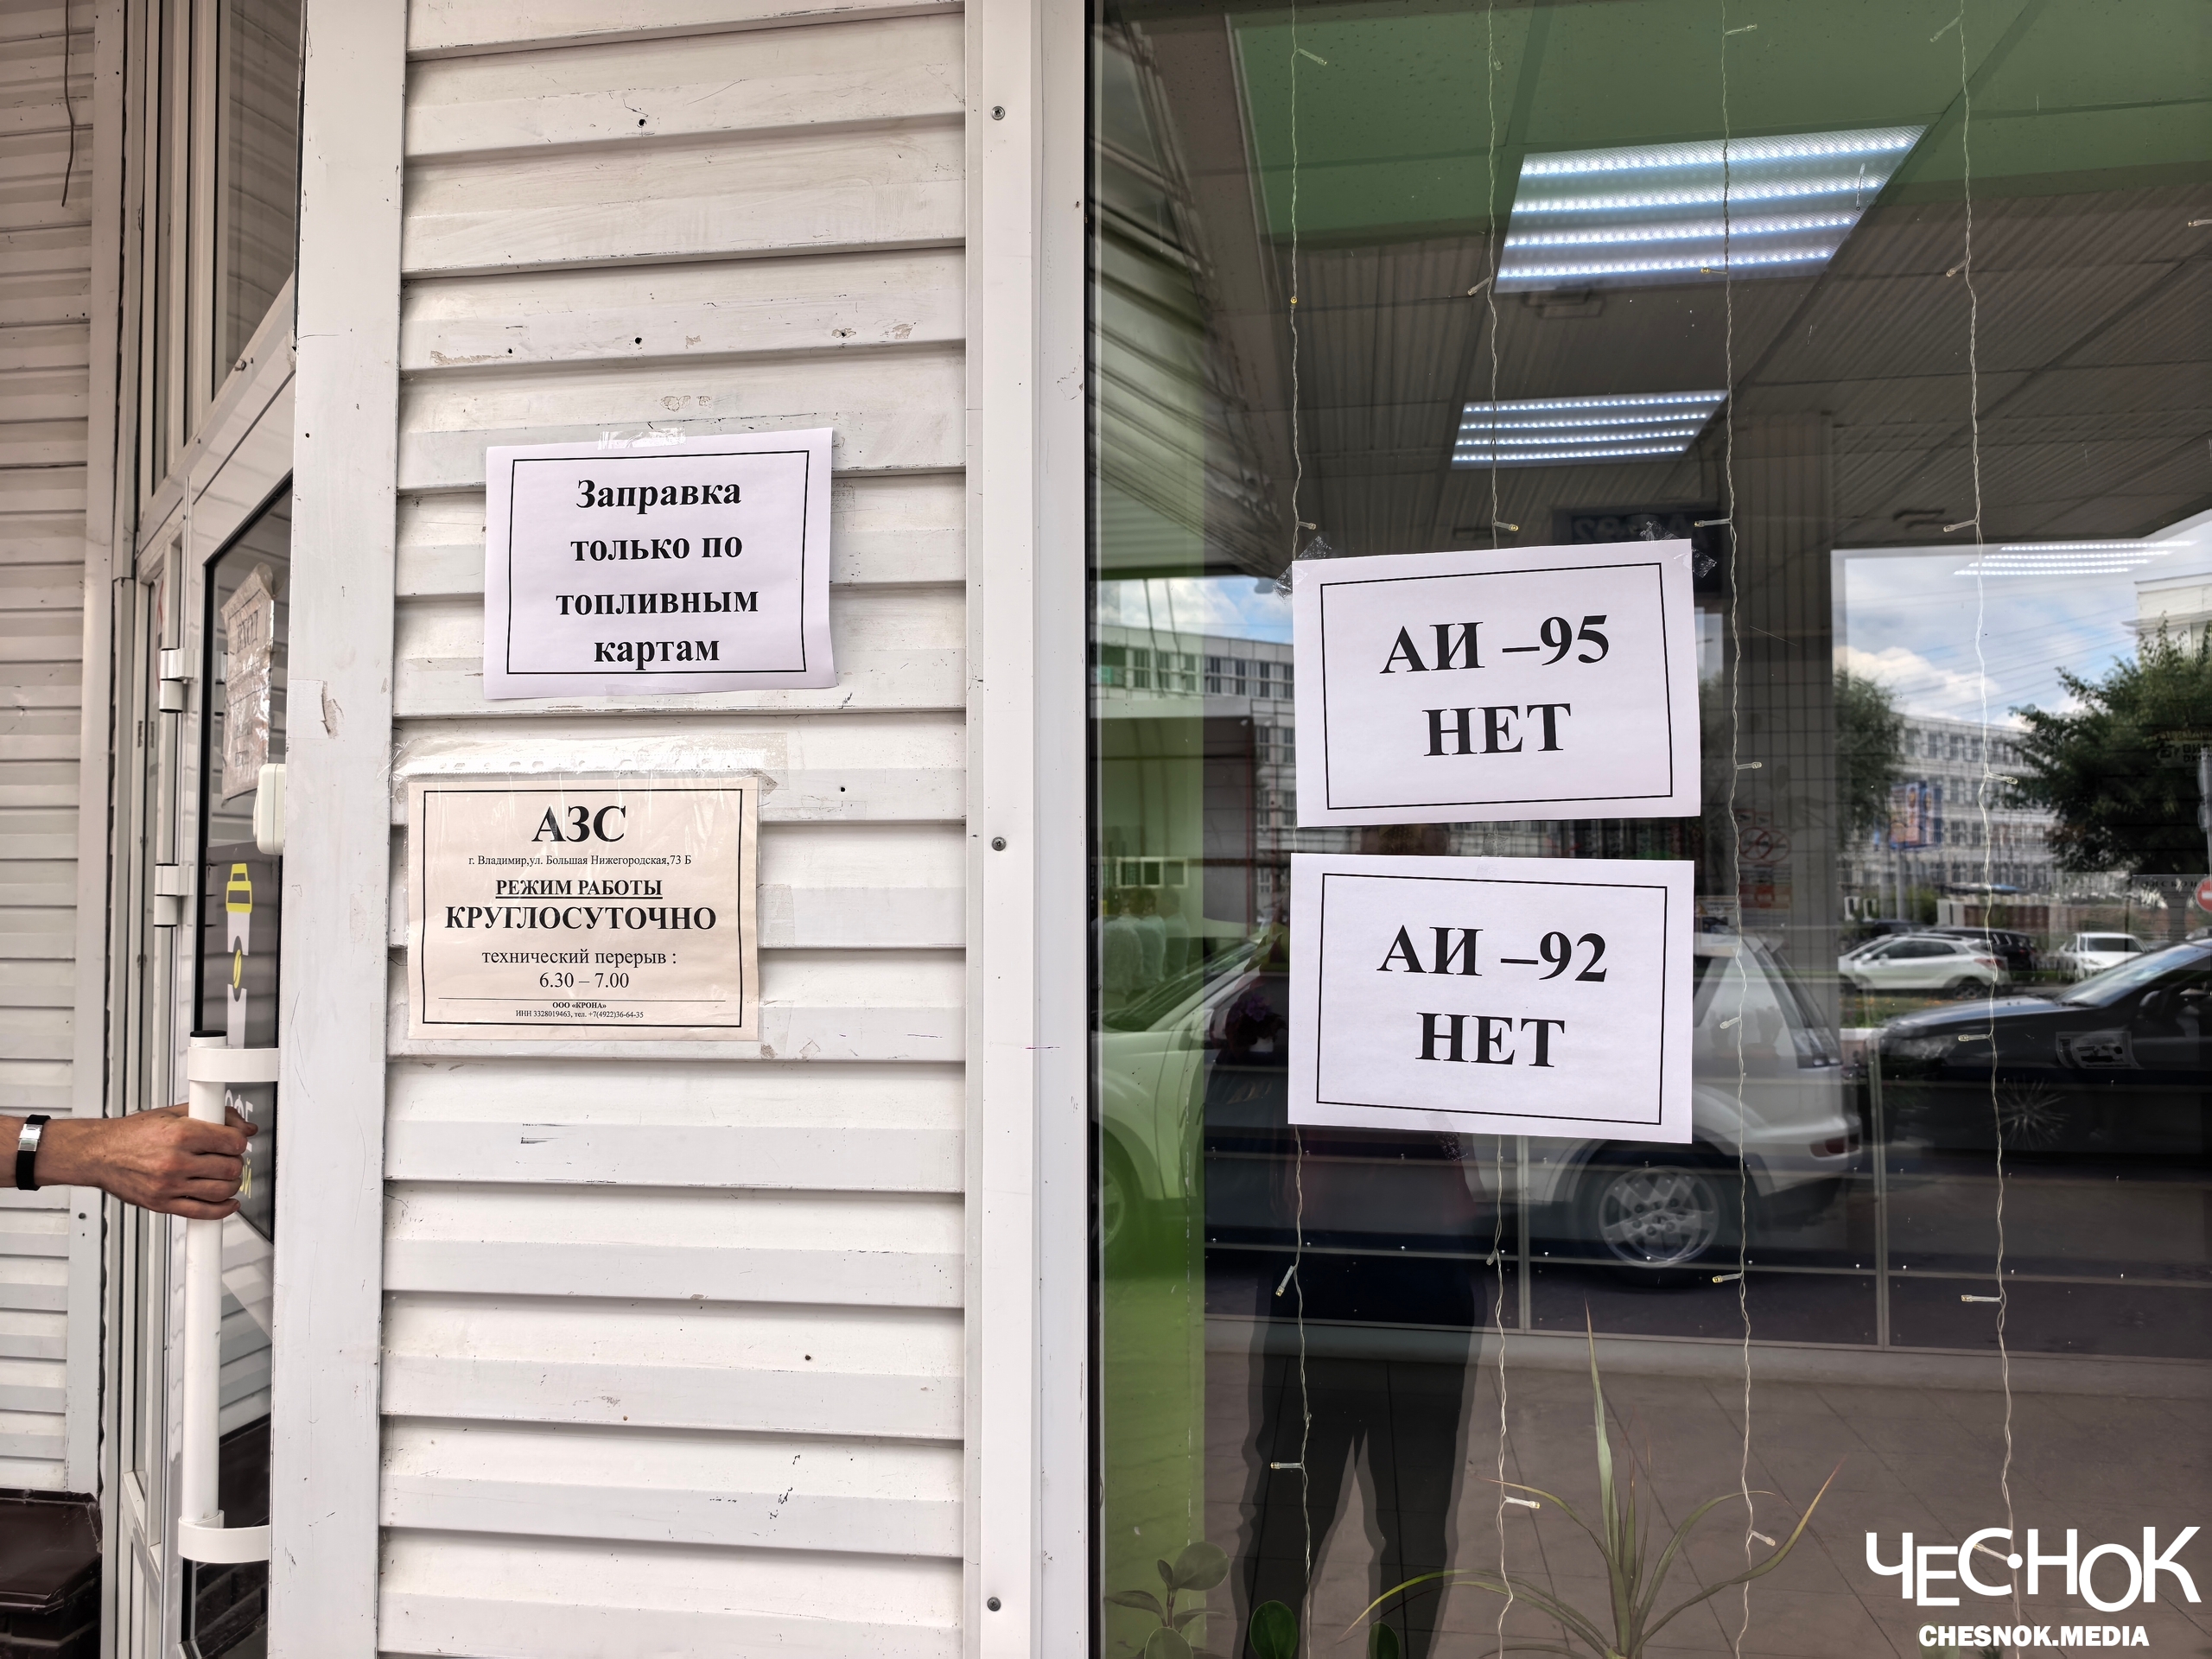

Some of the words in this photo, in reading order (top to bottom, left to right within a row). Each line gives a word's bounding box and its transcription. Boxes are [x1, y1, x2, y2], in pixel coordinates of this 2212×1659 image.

[575, 480, 742, 515] Заправка
[570, 537, 690, 562] только
[701, 537, 743, 558] по
[556, 591, 759, 616] топливным
[594, 640, 720, 671] картам
[1379, 621, 1485, 674] АИ
[1502, 614, 1610, 666] –95
[1421, 702, 1572, 757] НЕТ
[531, 805, 626, 842] АЗС
[546, 855, 588, 865] Большая
[590, 855, 682, 868] Нижегородская,73
[684, 855, 691, 865] Б
[496, 880, 572, 895] РЕЖИМ
[578, 880, 663, 896] РАБОТЫ
[445, 906, 716, 931] КРУГЛОСУТОЧНО
[481, 948, 589, 963] технический
[594, 952, 667, 969] перерыв
[1376, 924, 1484, 976] АИ
[1500, 931, 1607, 982] –92
[539, 972, 575, 988] 6.30
[594, 972, 629, 988] 7.00
[588, 1010, 644, 1019] +7(4922)36-64-35
[1414, 1012, 1566, 1068] НЕТ
